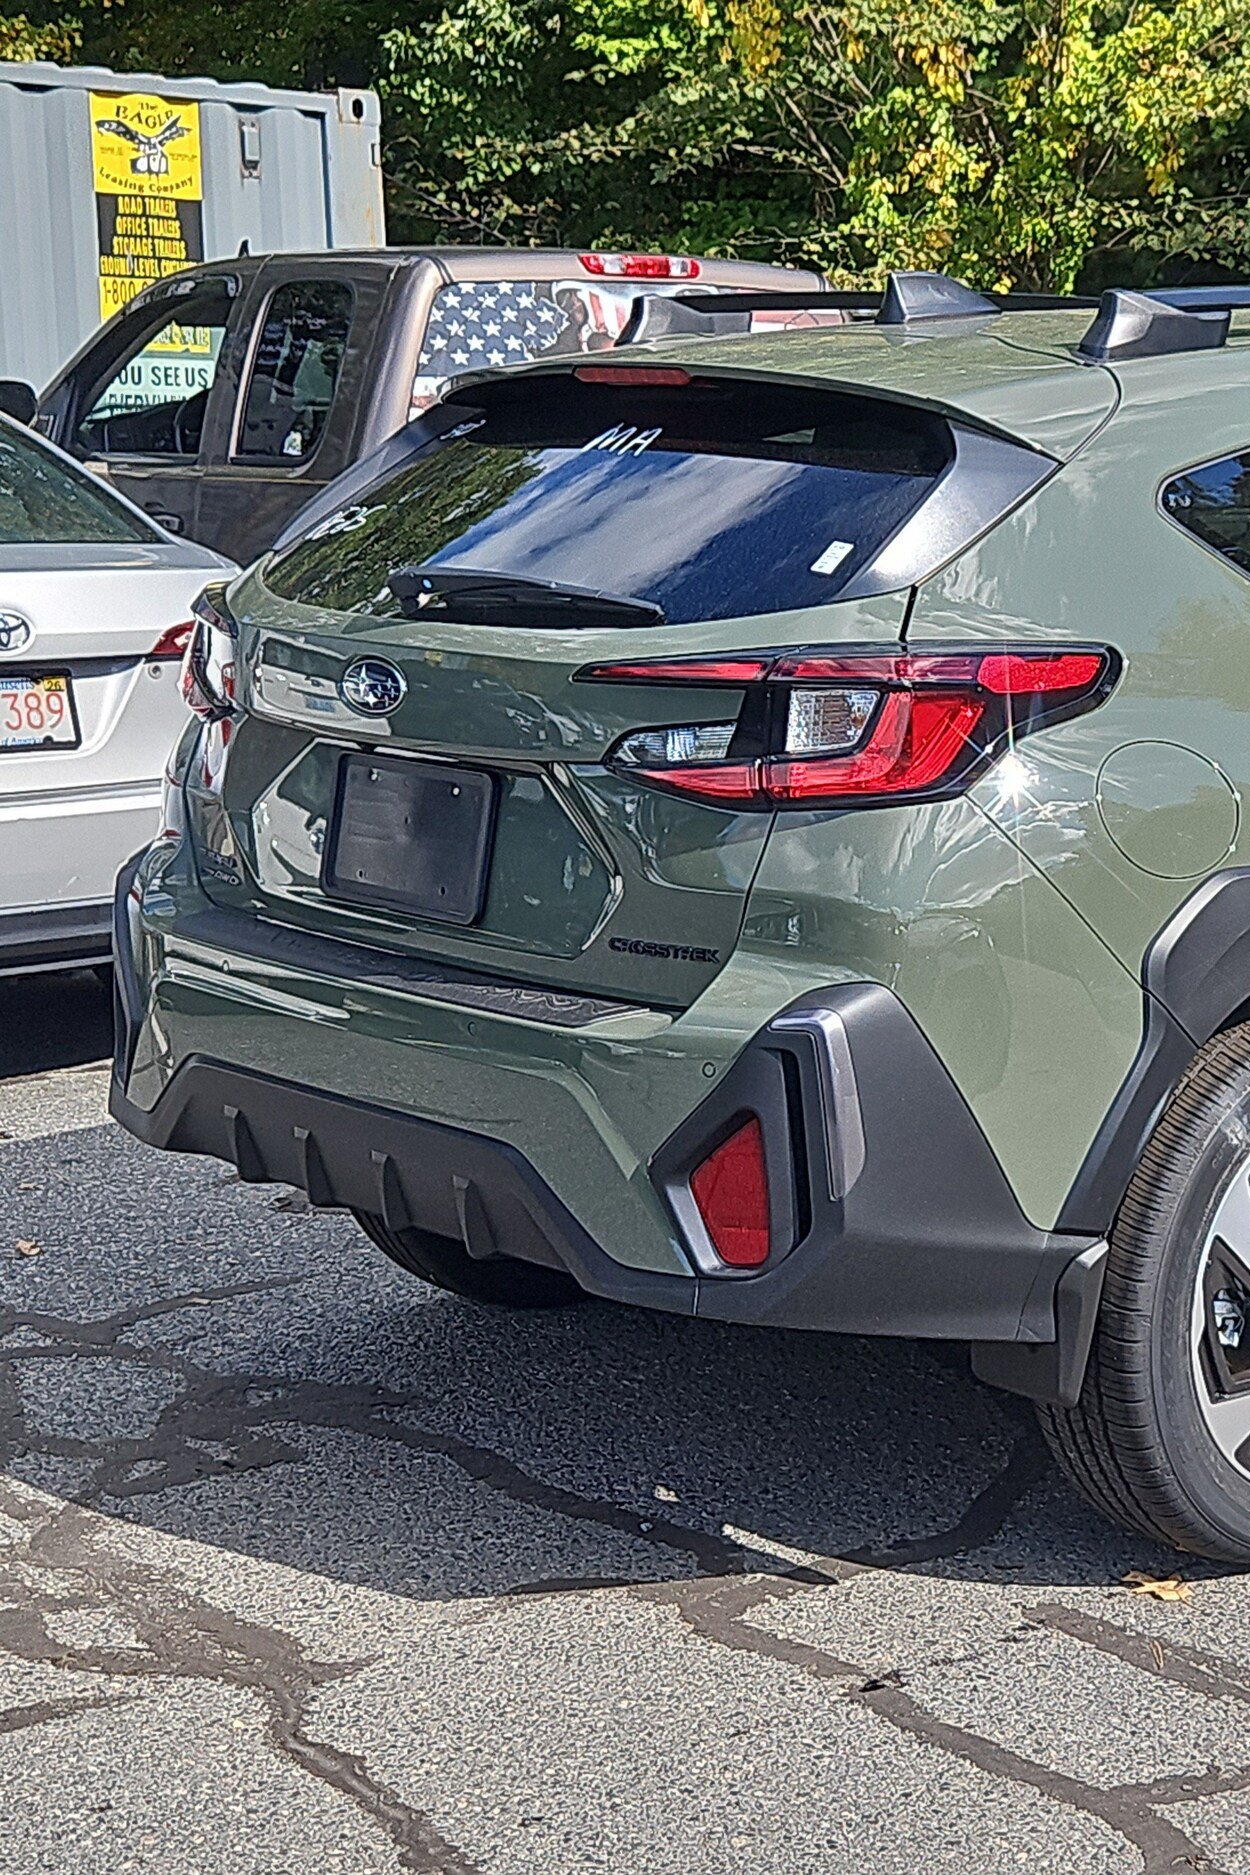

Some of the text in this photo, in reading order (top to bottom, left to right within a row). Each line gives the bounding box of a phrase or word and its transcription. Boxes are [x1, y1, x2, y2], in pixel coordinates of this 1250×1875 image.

[99, 166, 193, 194] Leasing Company
[117, 196, 143, 215] ROAD
[116, 215, 147, 235] OFFICE
[112, 236, 154, 256] STORAGE
[134, 257, 161, 278] LEVEL
[151, 366, 181, 386] SEE
[185, 367, 208, 389] US
[1, 692, 63, 731] 389
[608, 937, 720, 964] CROSSTREK
